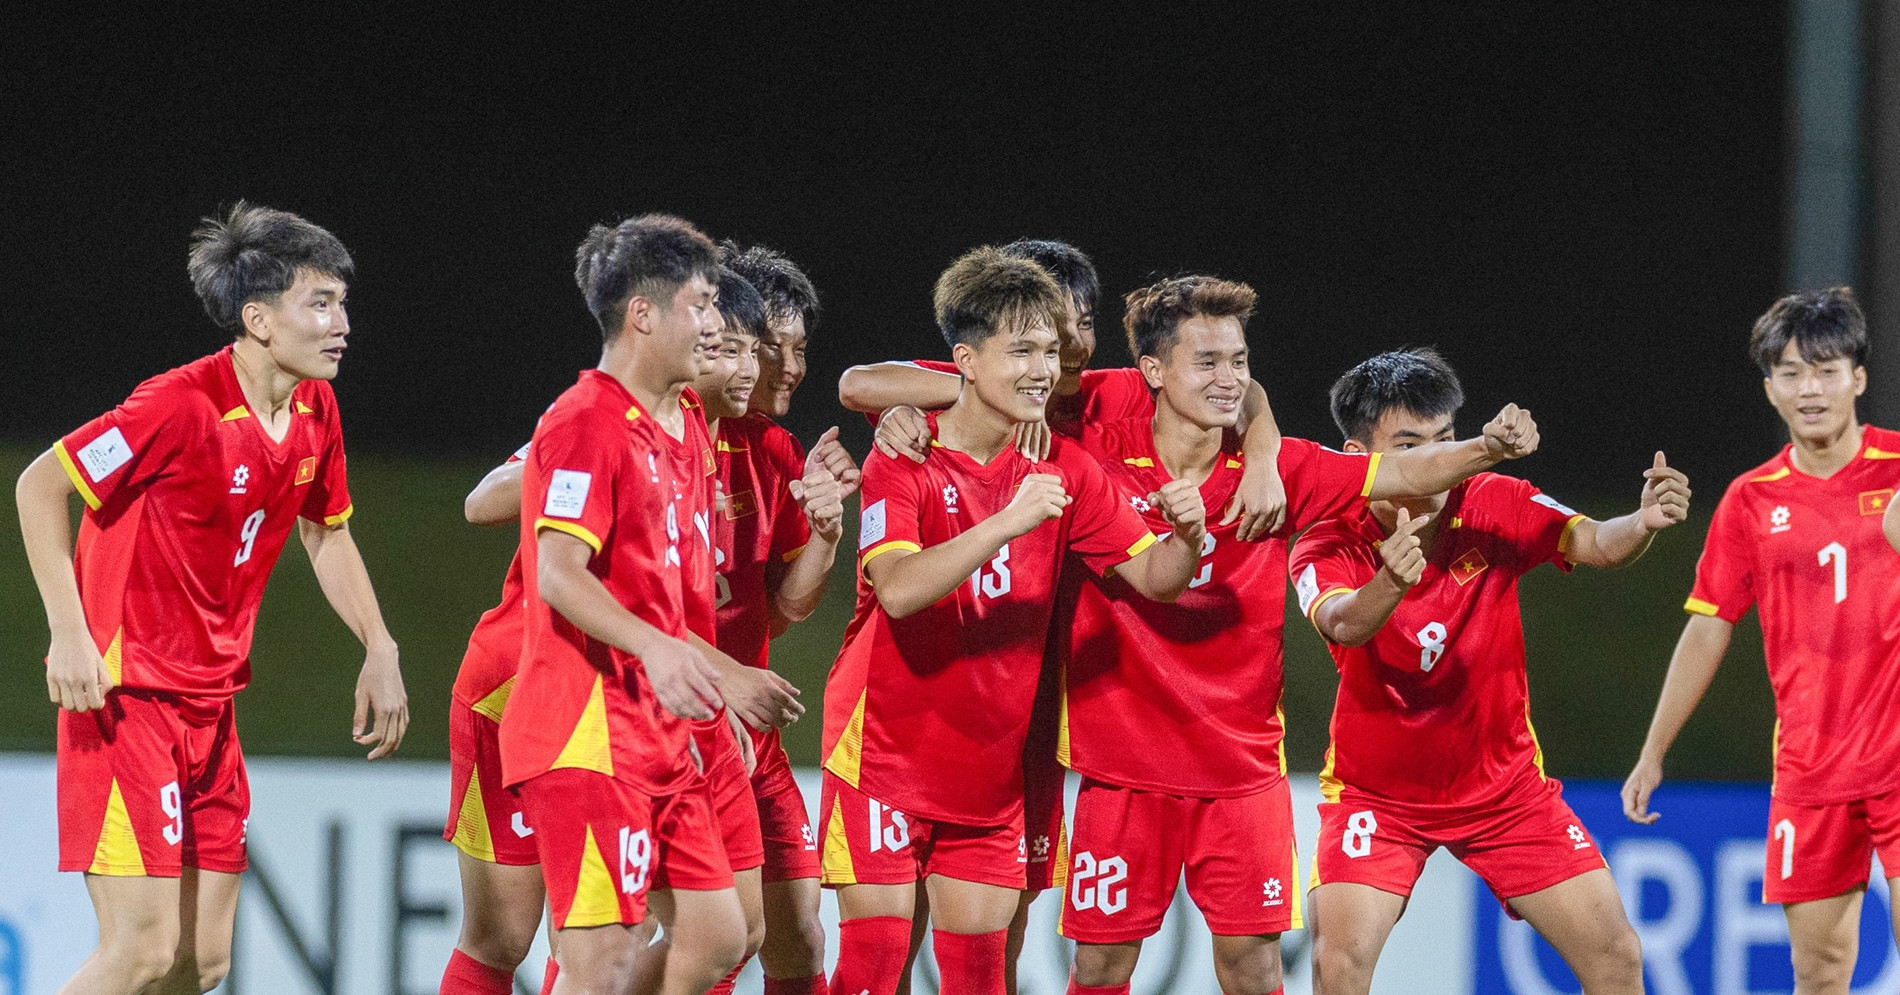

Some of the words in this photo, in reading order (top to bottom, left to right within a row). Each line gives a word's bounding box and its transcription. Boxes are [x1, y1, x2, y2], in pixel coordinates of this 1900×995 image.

[234, 509, 266, 567] 9
[1416, 621, 1448, 673] 8
[160, 781, 184, 846] 9
[868, 796, 910, 854] 13
[1341, 810, 1378, 859] 8
[618, 826, 653, 894] 19
[1070, 850, 1129, 916] 22
